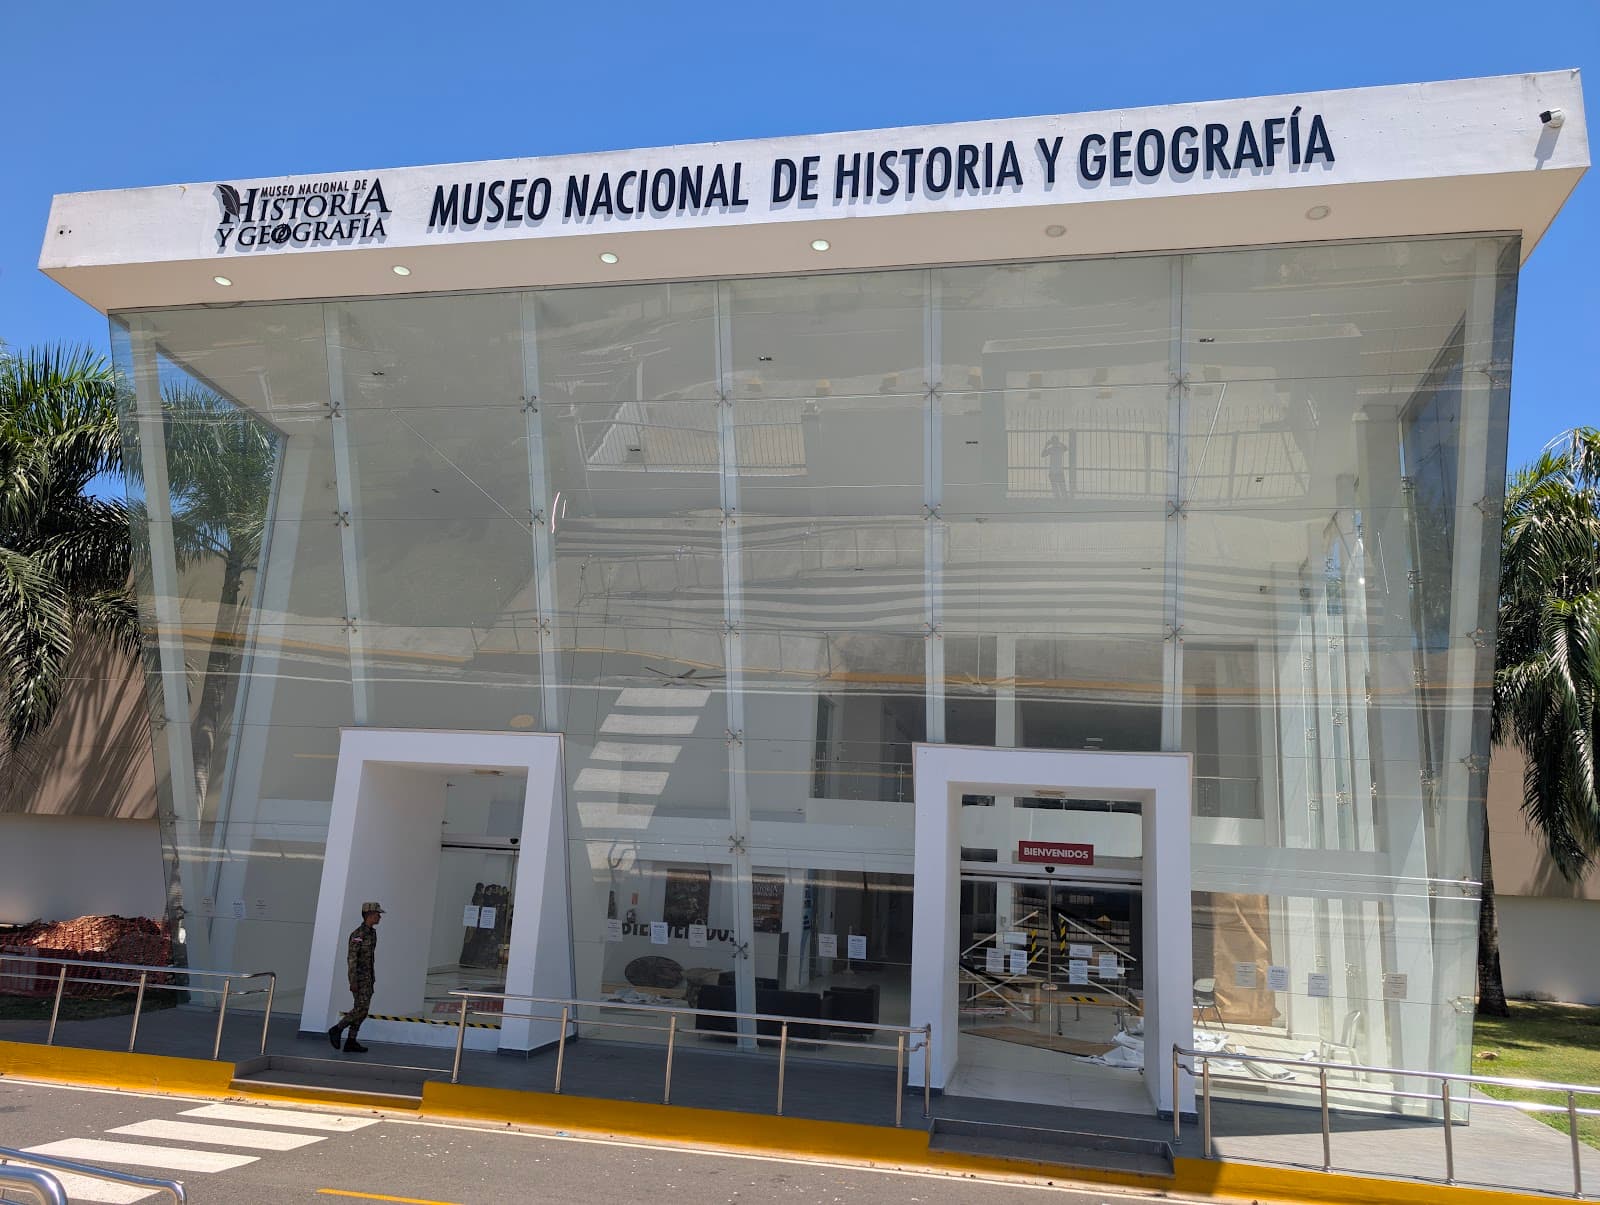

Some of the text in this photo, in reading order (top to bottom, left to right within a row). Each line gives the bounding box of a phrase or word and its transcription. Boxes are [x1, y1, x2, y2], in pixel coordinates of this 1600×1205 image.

[428, 105, 1335, 227] MUSEO NACIONAL DE HISTORIA Y GEOGRAFÍA
[219, 177, 392, 225] HISTORIA
[261, 178, 368, 198] MUSEO NACIONAL DE
[217, 212, 387, 247] Y GEOGRAFÍA
[1023, 847, 1089, 859] BIENVENIDOS
